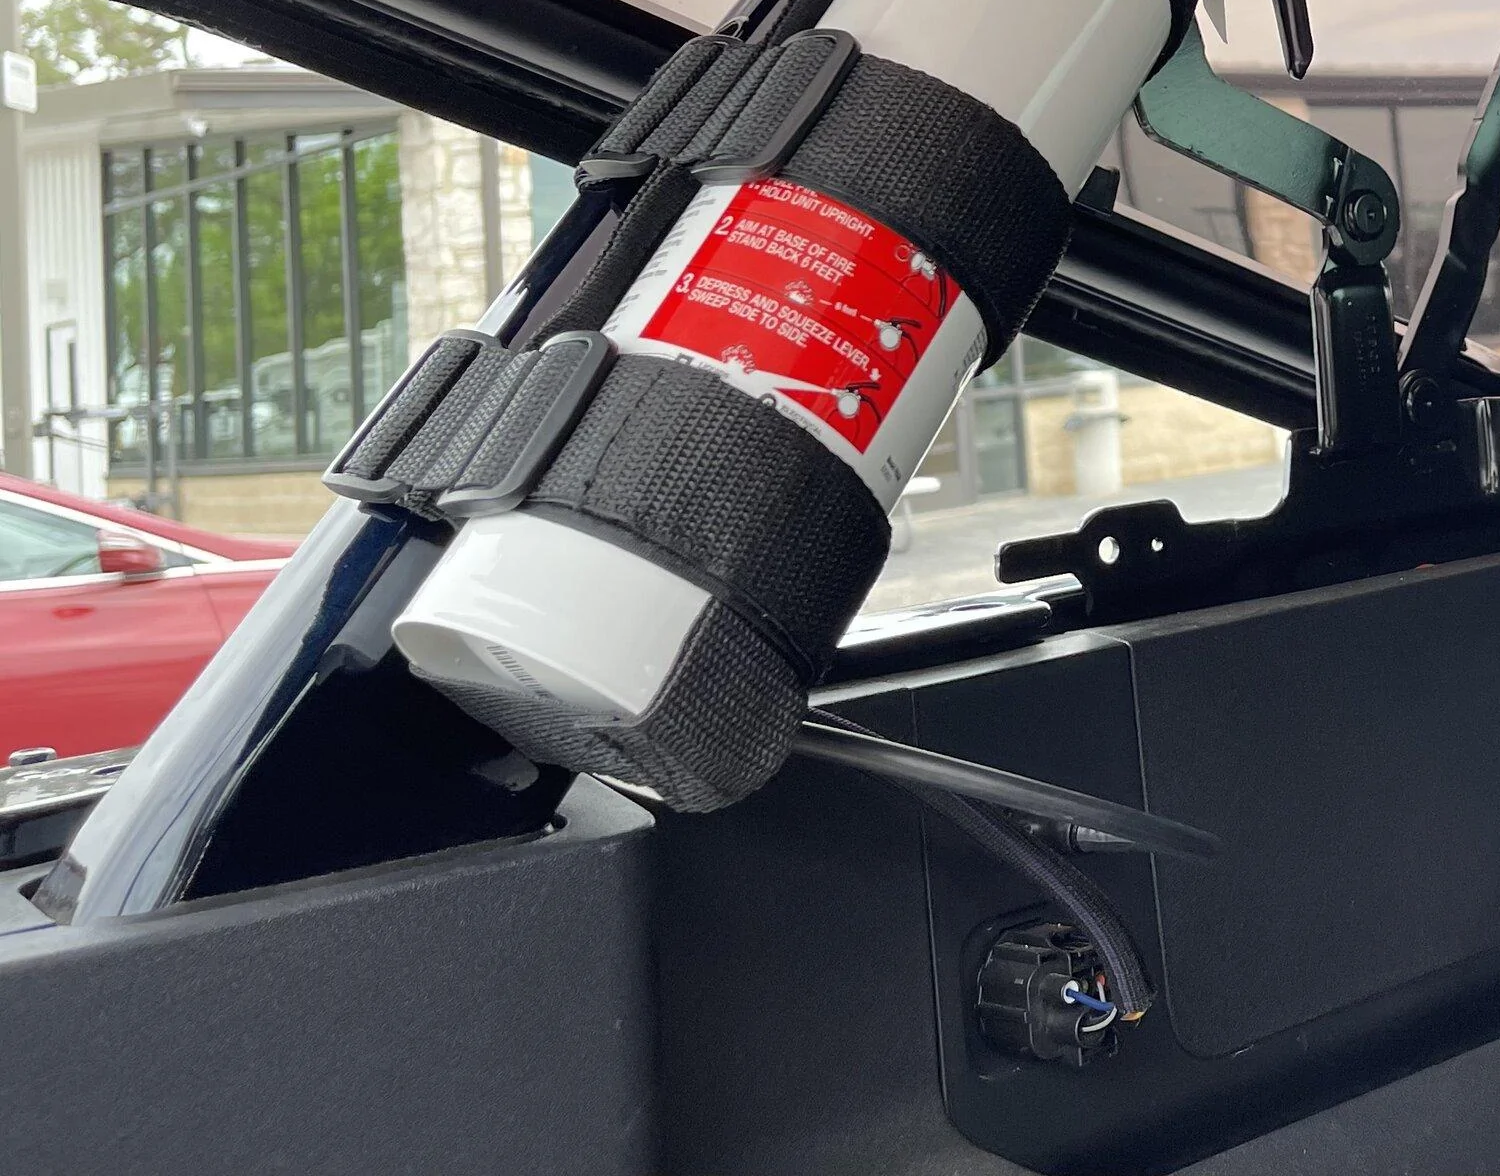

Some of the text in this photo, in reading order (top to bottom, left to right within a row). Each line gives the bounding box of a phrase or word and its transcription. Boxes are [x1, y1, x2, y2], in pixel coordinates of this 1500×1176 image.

[759, 184, 792, 201] HOLD
[790, 193, 822, 211] UNIT
[820, 203, 875, 240] UPRIGHT.
[727, 230, 768, 250] STAND
[765, 241, 802, 265] BACK
[800, 256, 812, 268] 6
[734, 218, 760, 234] AIM
[757, 224, 776, 238] AT
[774, 229, 809, 251] BASE
[807, 243, 828, 258] OF
[687, 288, 731, 309] SWEEP
[728, 301, 762, 322] SIDE
[759, 311, 779, 330] TO
[696, 275, 752, 302] DEPRESS
[749, 293, 779, 314] AND
[777, 305, 837, 345] SQUEEZE
